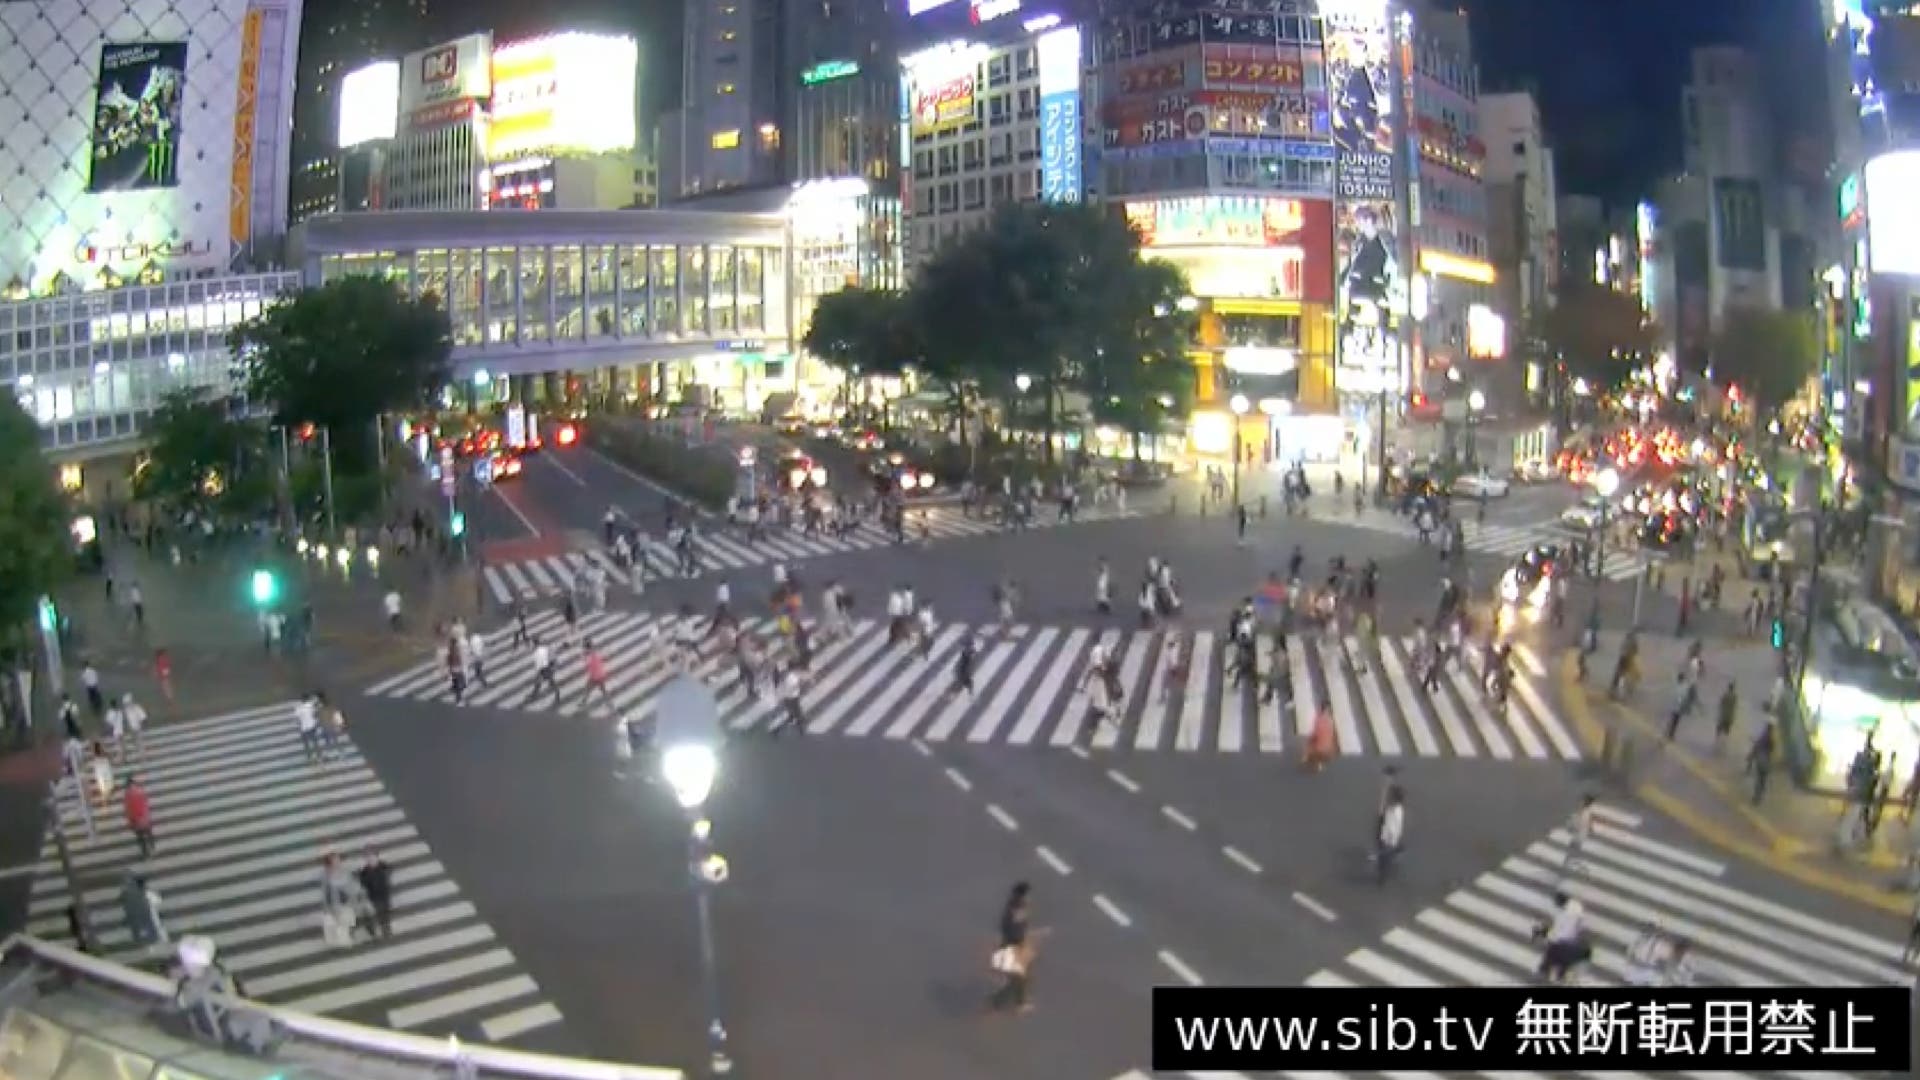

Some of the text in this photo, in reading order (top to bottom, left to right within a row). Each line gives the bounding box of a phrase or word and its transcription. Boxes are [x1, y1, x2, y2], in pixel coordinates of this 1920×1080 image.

[1206, 60, 1300, 83] コンタクト
[1142, 117, 1181, 144] ガスト
[1340, 152, 1391, 167] JUNHO
